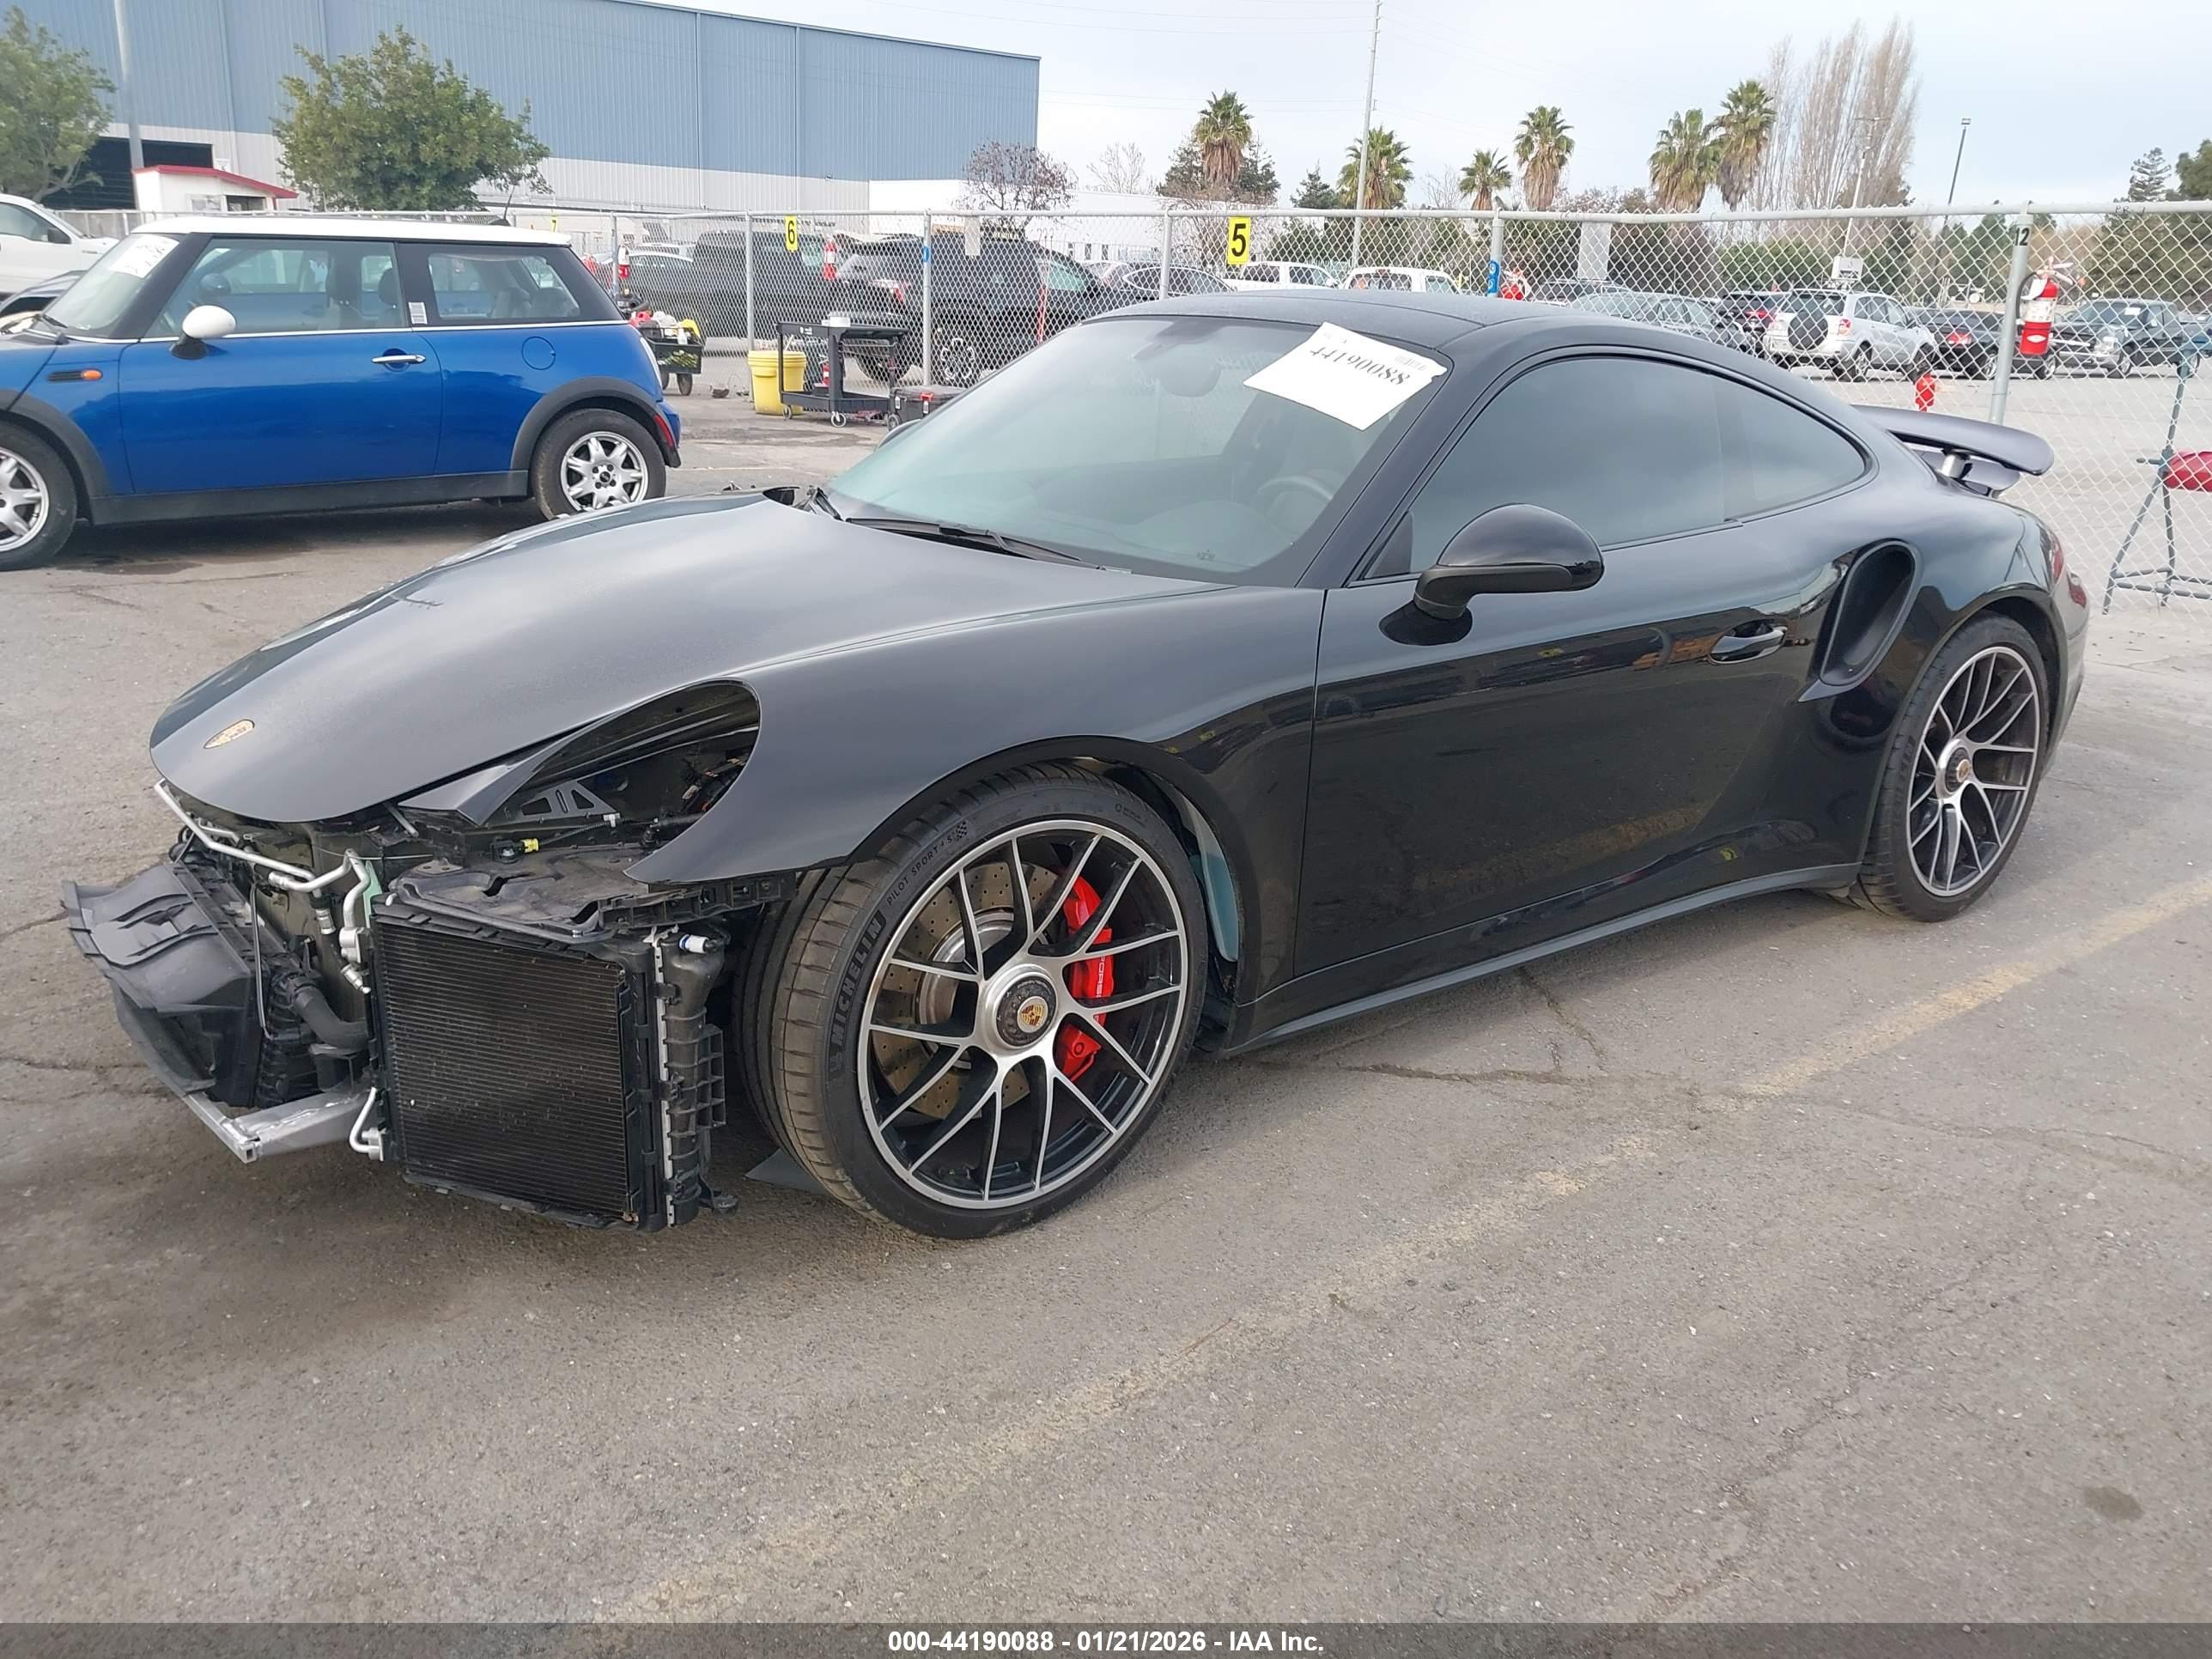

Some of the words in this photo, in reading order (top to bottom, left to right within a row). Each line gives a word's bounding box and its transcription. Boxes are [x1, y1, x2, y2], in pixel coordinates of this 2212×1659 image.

[787, 220, 796, 245] 6
[1231, 222, 1247, 257] 5
[2014, 228, 2030, 246] 12
[1310, 346, 1410, 386] 44190088
[886, 876, 909, 906] PILOT
[910, 846, 940, 877] SPORT
[830, 920, 882, 1044] MICHELIN
